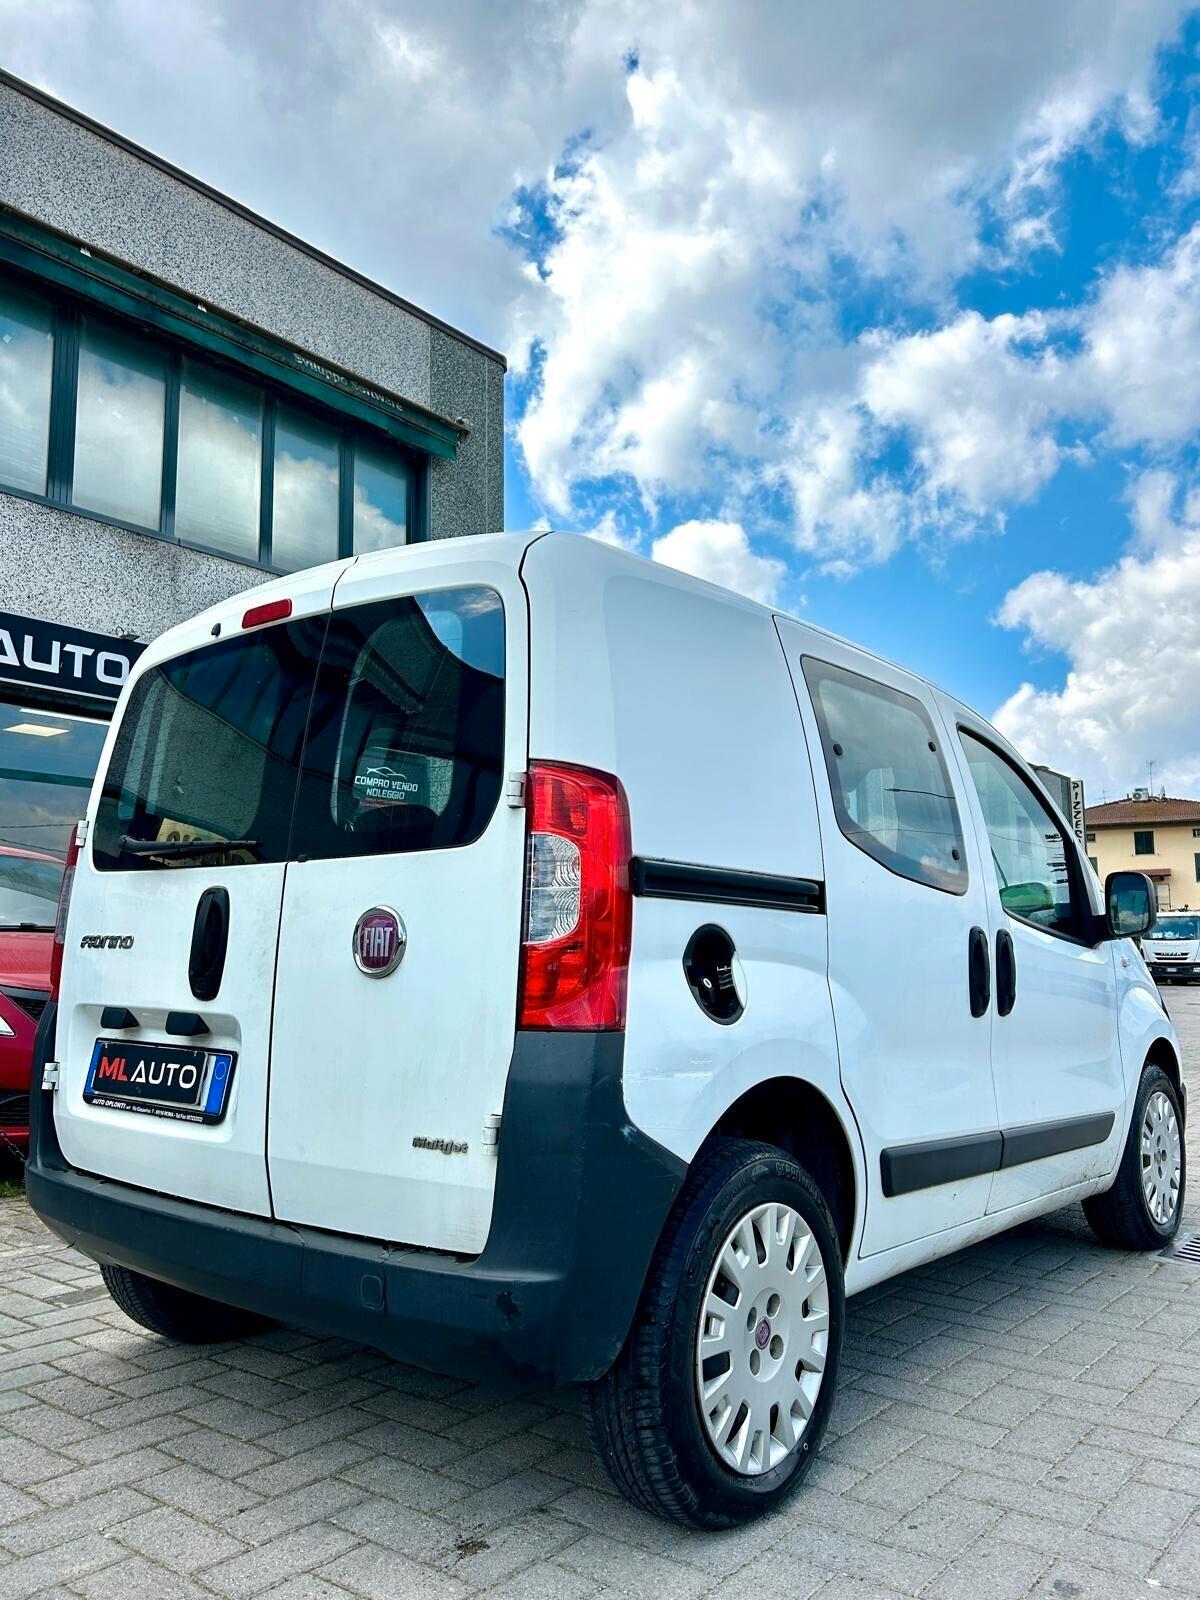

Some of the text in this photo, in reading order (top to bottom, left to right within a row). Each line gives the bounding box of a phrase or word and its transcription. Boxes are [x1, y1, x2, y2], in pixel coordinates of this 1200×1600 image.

[354, 775, 419, 792] COMPRO VENDO
[366, 788, 405, 800] NOLEGGIO
[362, 927, 394, 957] FIAT
[98, 1056, 197, 1089] ML AUTO
[92, 1098, 105, 1106] AUTO
